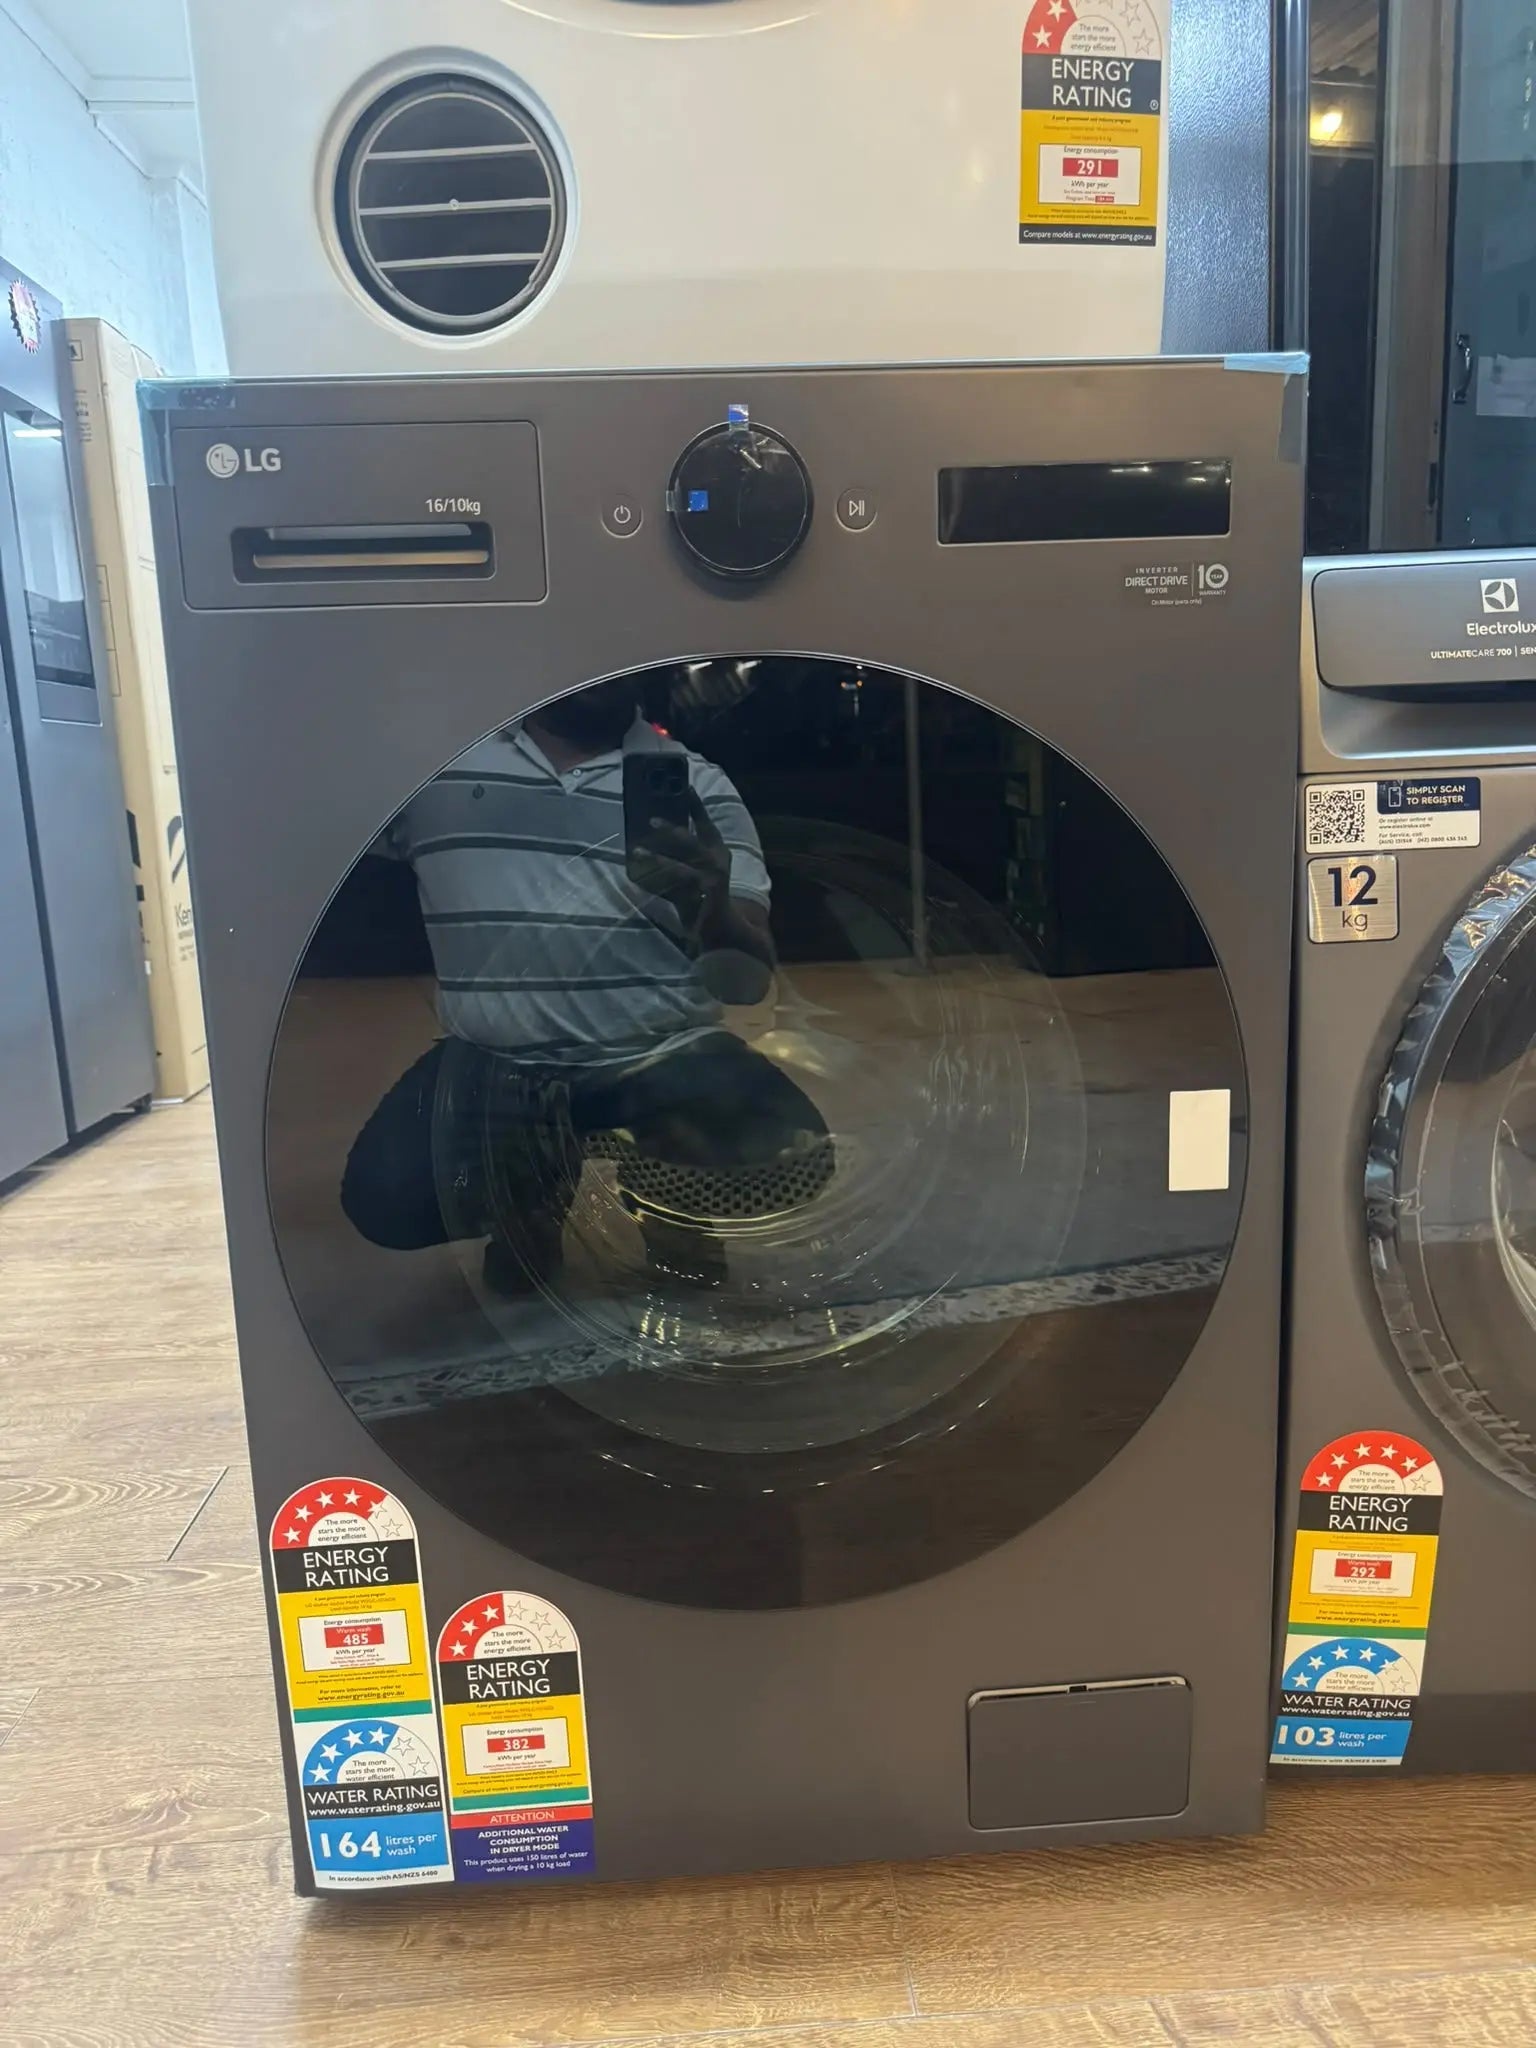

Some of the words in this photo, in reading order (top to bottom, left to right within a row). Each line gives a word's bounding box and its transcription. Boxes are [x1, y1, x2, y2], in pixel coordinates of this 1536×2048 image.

[1071, 44, 1091, 52] energy
[1052, 58, 1134, 82] ENERGY
[1053, 86, 1131, 108] RATING
[1064, 146, 1082, 154] Energy
[1084, 147, 1118, 155] consumption
[1077, 160, 1102, 175] 291
[1023, 230, 1051, 239] Compare
[1082, 232, 1152, 241] www.energyrating.gov.au
[244, 448, 281, 472] LG
[425, 498, 480, 515] 16/10kg
[1125, 577, 1158, 586] DIRECT
[1160, 576, 1188, 585] DRIVE
[1198, 564, 1229, 589] 10
[1467, 621, 1536, 635] Electrolux
[1431, 649, 1494, 659] ULTIMATECARE
[1496, 648, 1512, 656] 700
[1406, 786, 1438, 794] SIMPLY
[1440, 785, 1465, 793] SCAN
[1422, 796, 1463, 804] REGISTER
[1327, 866, 1378, 907] 12
[1342, 910, 1368, 931] kg
[1329, 1496, 1412, 1512] ENERGY
[1329, 1514, 1408, 1532] RATING
[303, 1546, 388, 1568] ENERGY
[305, 1566, 389, 1588] RATING
[1350, 1567, 1376, 1578] 292
[343, 1633, 369, 1645] 485
[363, 1648, 376, 1656] year
[466, 1659, 550, 1680] ENERGY
[318, 1690, 405, 1701] www.energyrating.gov.au
[469, 1678, 550, 1699] RATING
[1284, 1694, 1344, 1707] WATER
[1348, 1698, 1411, 1709] RATING
[1282, 1706, 1410, 1718] www.waterrating.gov.au
[1278, 1725, 1335, 1746] 103
[1339, 1731, 1365, 1739] litres
[1367, 1733, 1386, 1741] per
[504, 1738, 529, 1751] 382
[352, 1759, 366, 1767] The
[307, 1789, 369, 1805] WATER
[373, 1784, 439, 1800] RATING
[308, 1800, 441, 1816] www.waterrating.gov.au
[490, 1810, 555, 1824] ATTENTION
[478, 1828, 536, 1839] ADDITIONAL
[537, 1825, 569, 1833] WATER
[320, 1830, 382, 1858] 164
[386, 1835, 415, 1845] litres
[418, 1833, 438, 1845] per
[490, 1835, 559, 1846] CONSUMPTION
[386, 1846, 416, 1856] wash
[503, 1845, 531, 1853] DRYER
[532, 1843, 560, 1851] MODE
[480, 1858, 507, 1866] product
[506, 1864, 529, 1872] drying
[337, 1874, 375, 1882] accordance
[376, 1873, 392, 1881] with
